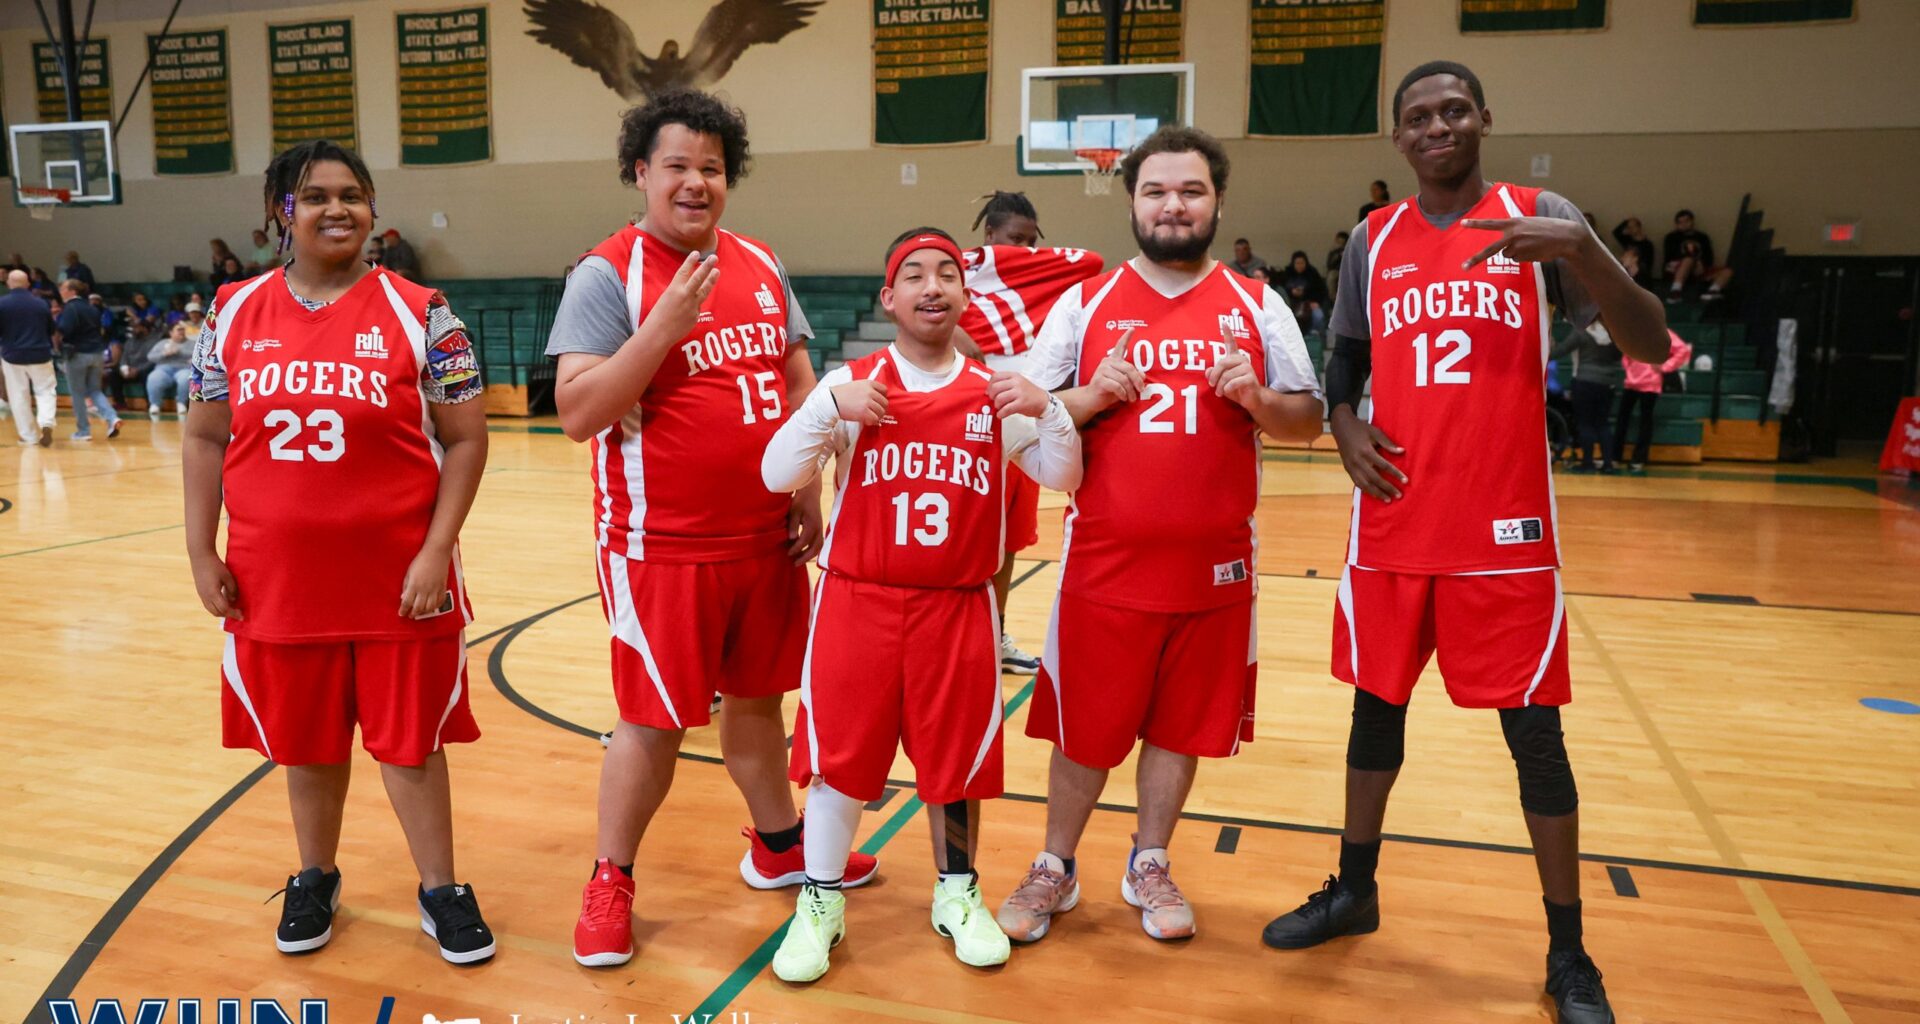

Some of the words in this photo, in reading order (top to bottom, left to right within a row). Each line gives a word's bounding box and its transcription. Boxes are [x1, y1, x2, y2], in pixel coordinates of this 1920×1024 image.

[878, 6, 984, 25] BASKETBALL
[1065, 0, 1173, 14] BASALL
[441, 13, 478, 29] ISLAND
[185, 34, 219, 47] ISLAND
[308, 25, 344, 39] ISLAND
[405, 33, 432, 48] STATE
[434, 29, 478, 46] CHAMPIONS
[156, 53, 178, 66] STATE
[181, 50, 219, 64] CHAMPIONS
[277, 45, 300, 58] STATE
[303, 41, 344, 55] CHAMPIONS
[434, 48, 457, 62] TRACK
[464, 45, 486, 59] FIELD
[152, 69, 181, 81] CROSS
[183, 65, 224, 80] COUNTRY
[299, 59, 320, 72] TRACK
[329, 56, 349, 69] FIELD
[1381, 280, 1523, 338] ROGERS
[681, 322, 788, 377] ROGERS
[1107, 339, 1251, 373] OGER
[1412, 329, 1472, 387] 12
[432, 353, 476, 371] YEAH
[237, 360, 389, 409] ROGERS
[736, 371, 782, 425] 15
[1139, 382, 1198, 435] 21
[263, 409, 346, 462] 23
[861, 441, 990, 496] ROGERS
[891, 492, 950, 547] 13
